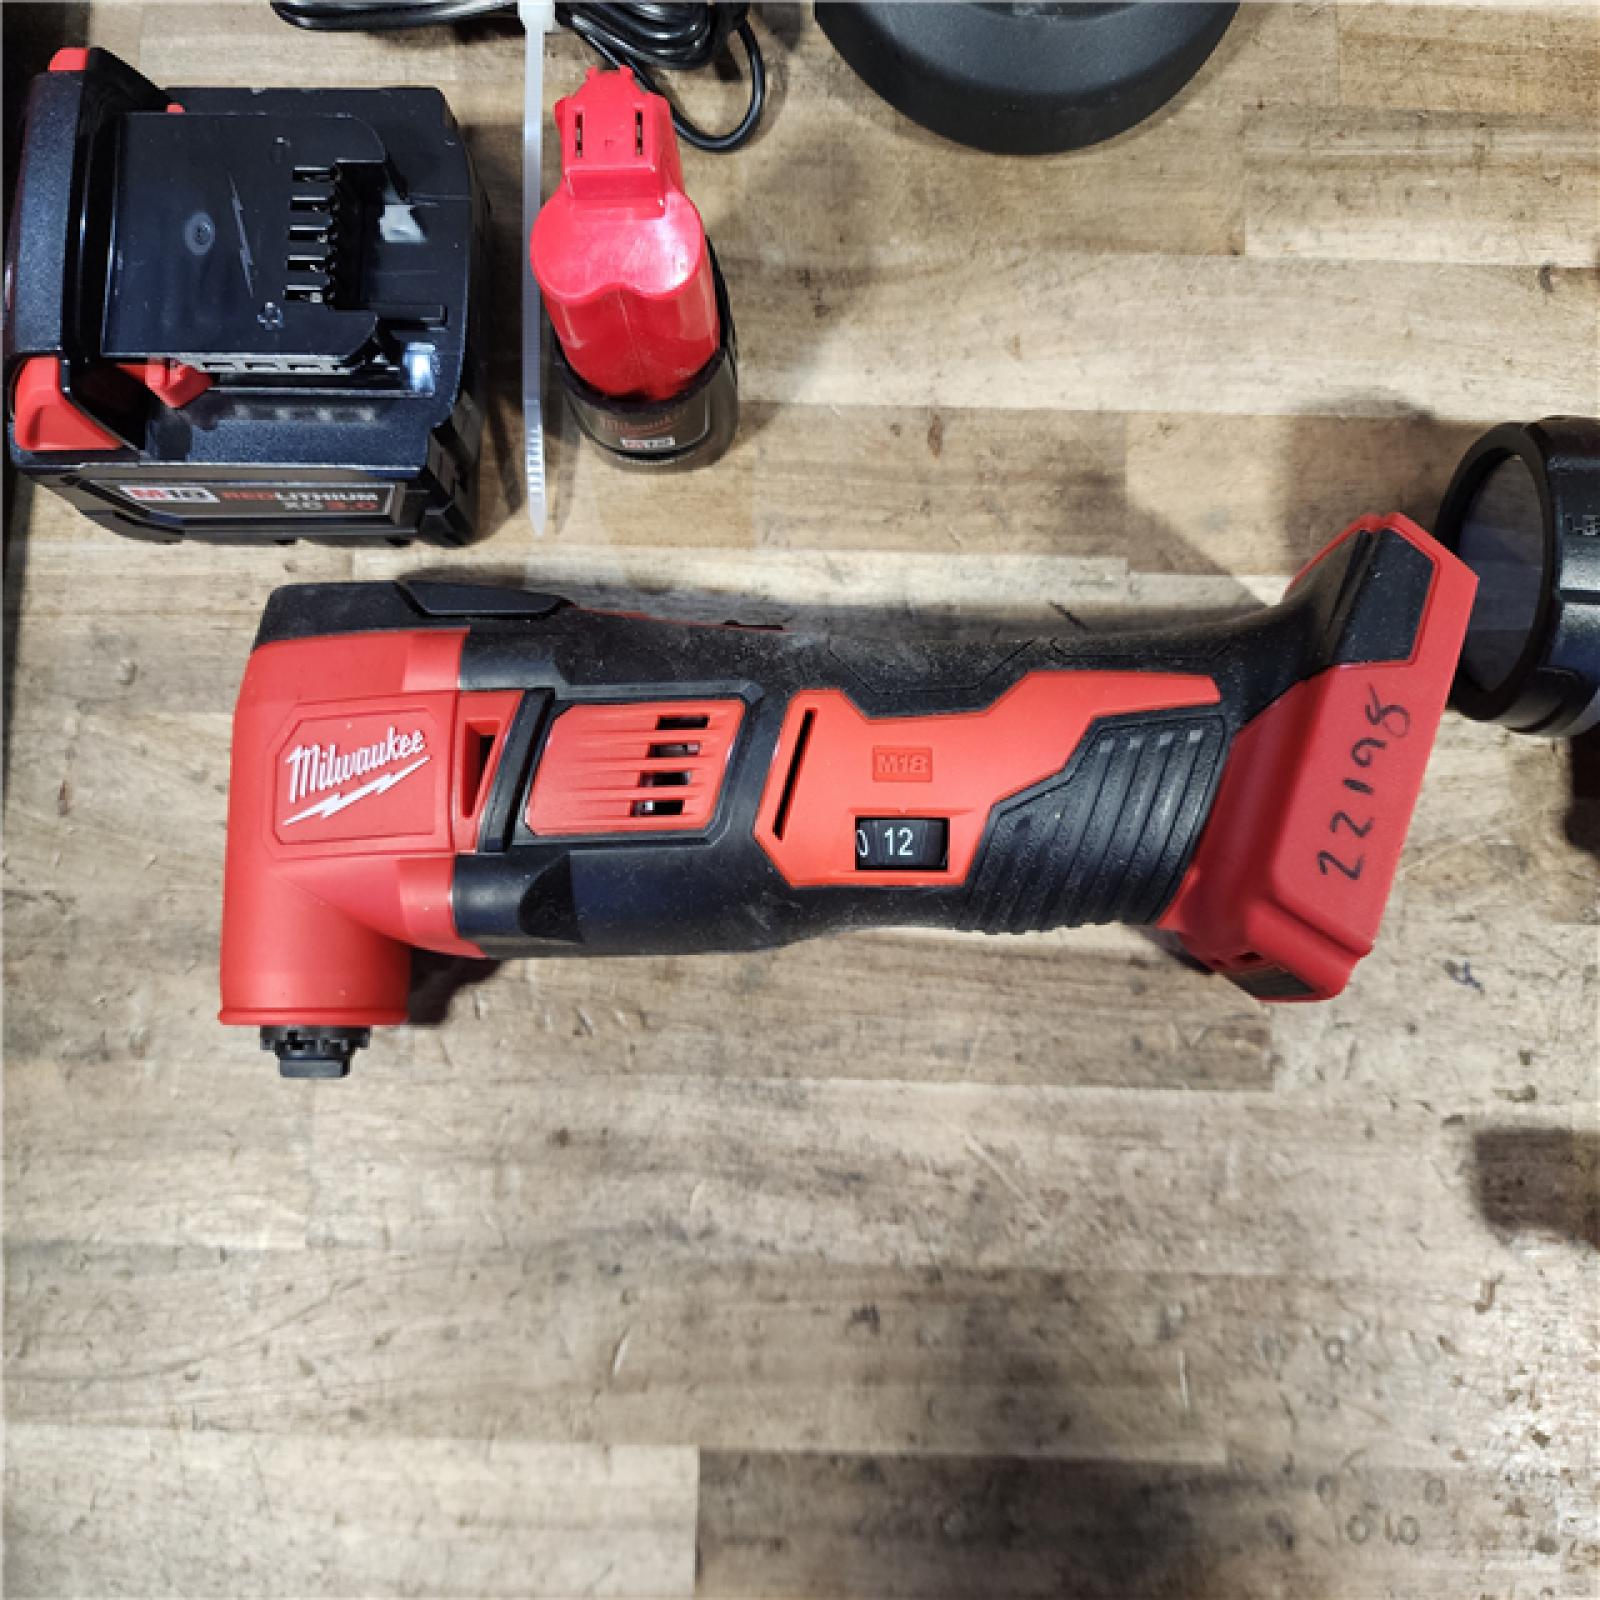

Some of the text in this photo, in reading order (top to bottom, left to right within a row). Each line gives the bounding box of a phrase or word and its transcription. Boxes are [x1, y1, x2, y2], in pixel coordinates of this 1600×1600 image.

[285, 725, 426, 803] Milwaukee
[876, 753, 928, 773] M18
[1316, 682, 1411, 881] 22198
[884, 826, 914, 856] 12
